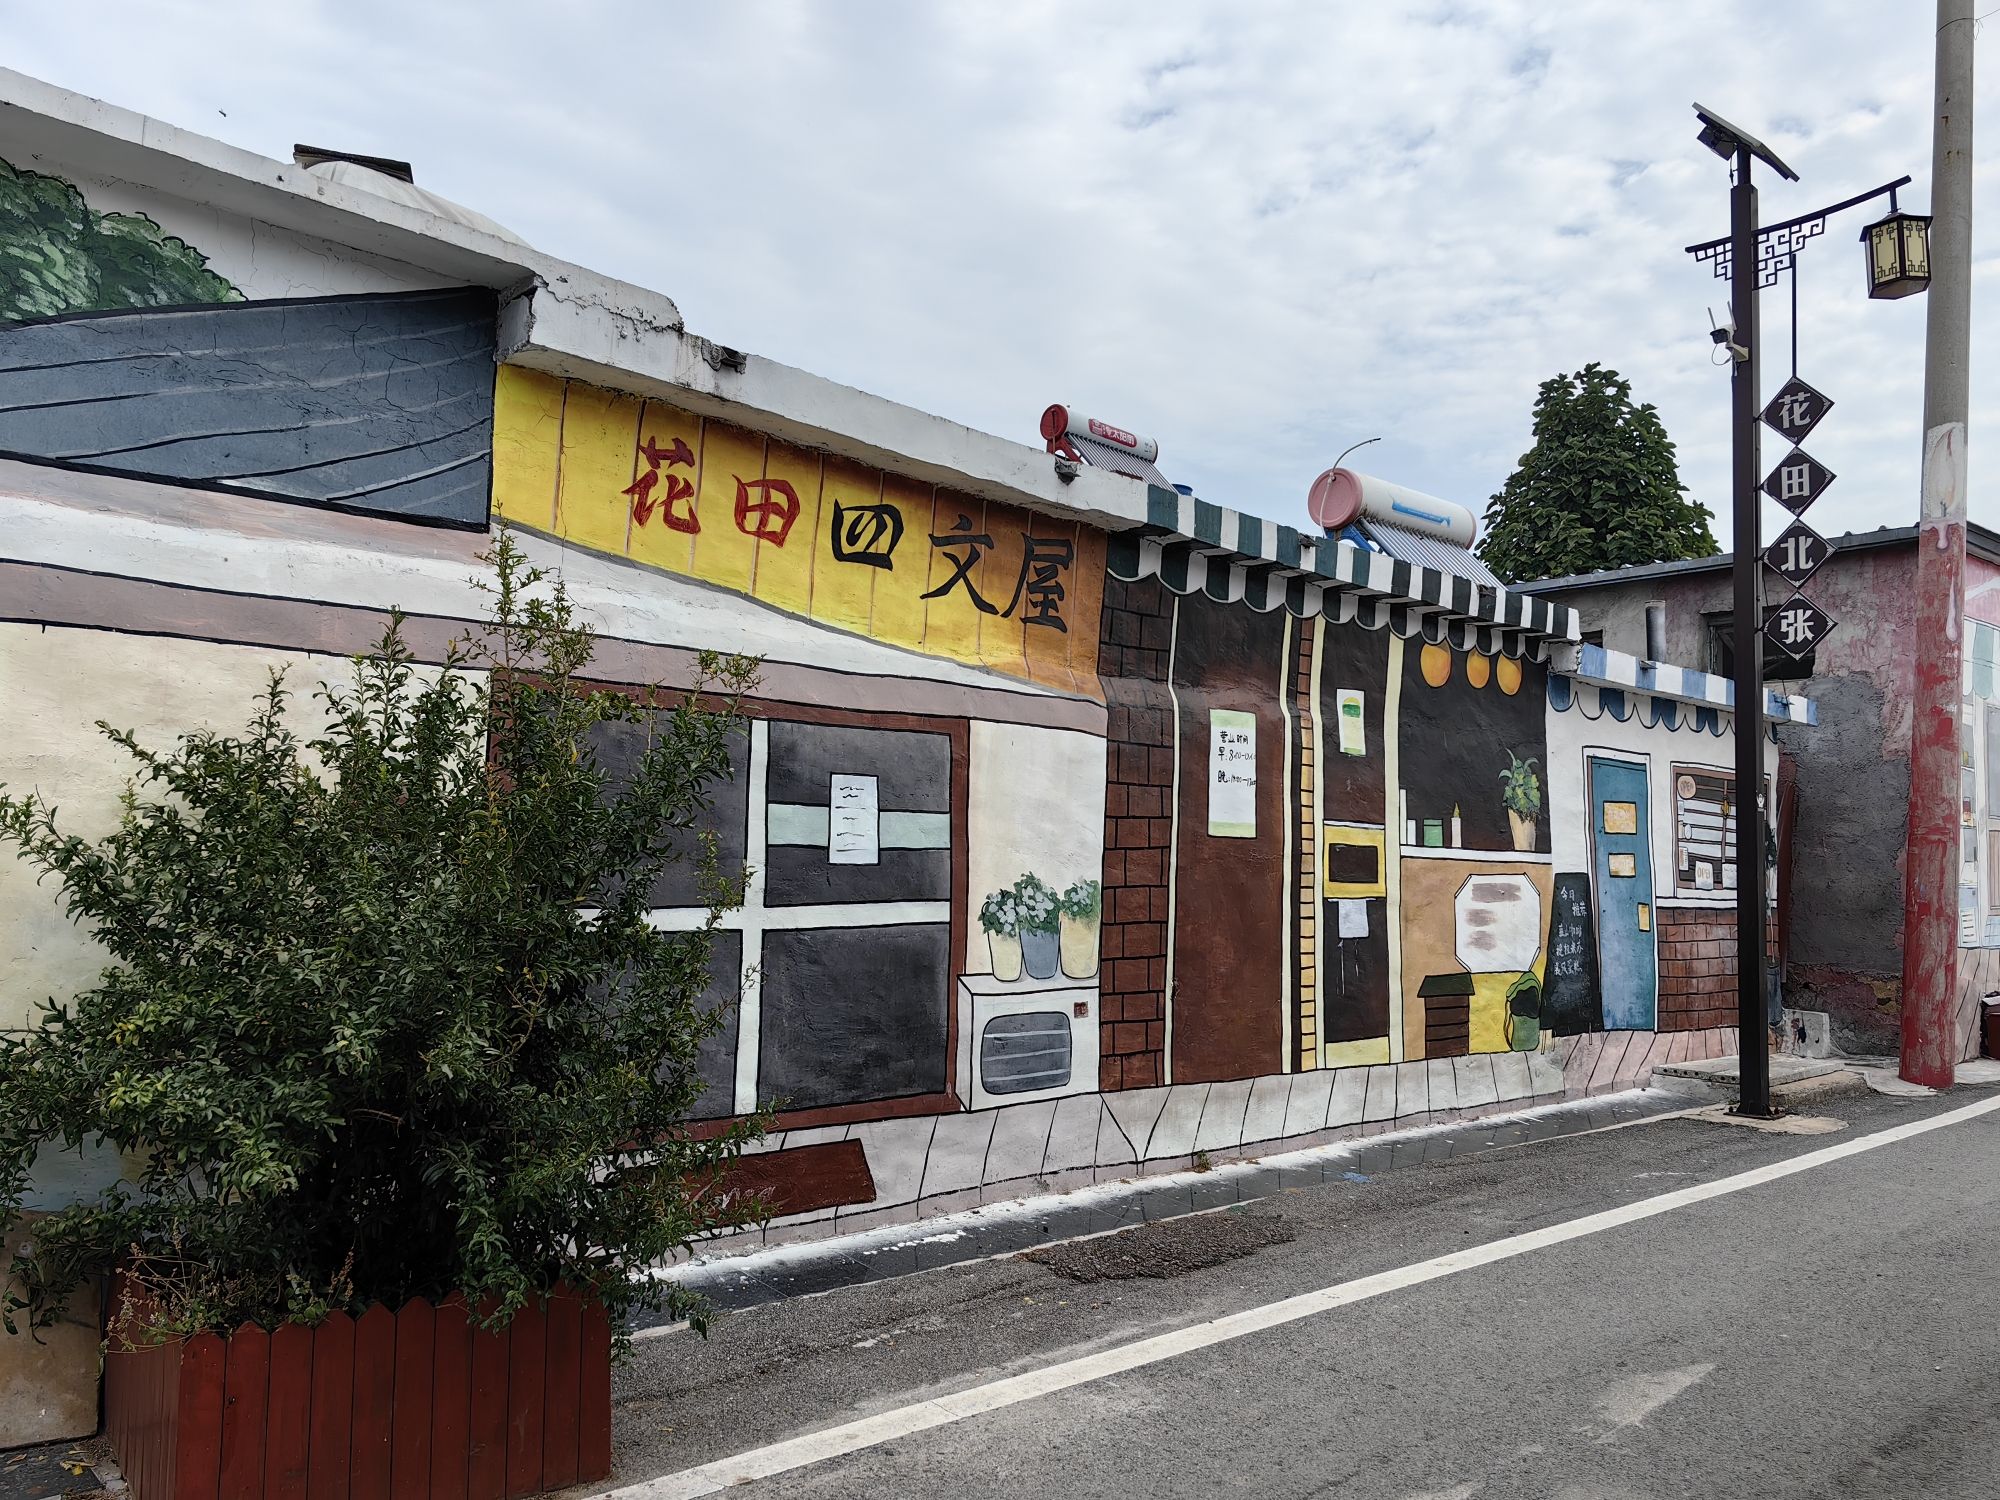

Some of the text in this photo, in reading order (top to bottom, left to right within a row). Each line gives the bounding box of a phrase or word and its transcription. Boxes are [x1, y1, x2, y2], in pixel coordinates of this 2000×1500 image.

[1778, 392, 1815, 644] 花田北张
[1220, 730, 1248, 744] 营业时间
